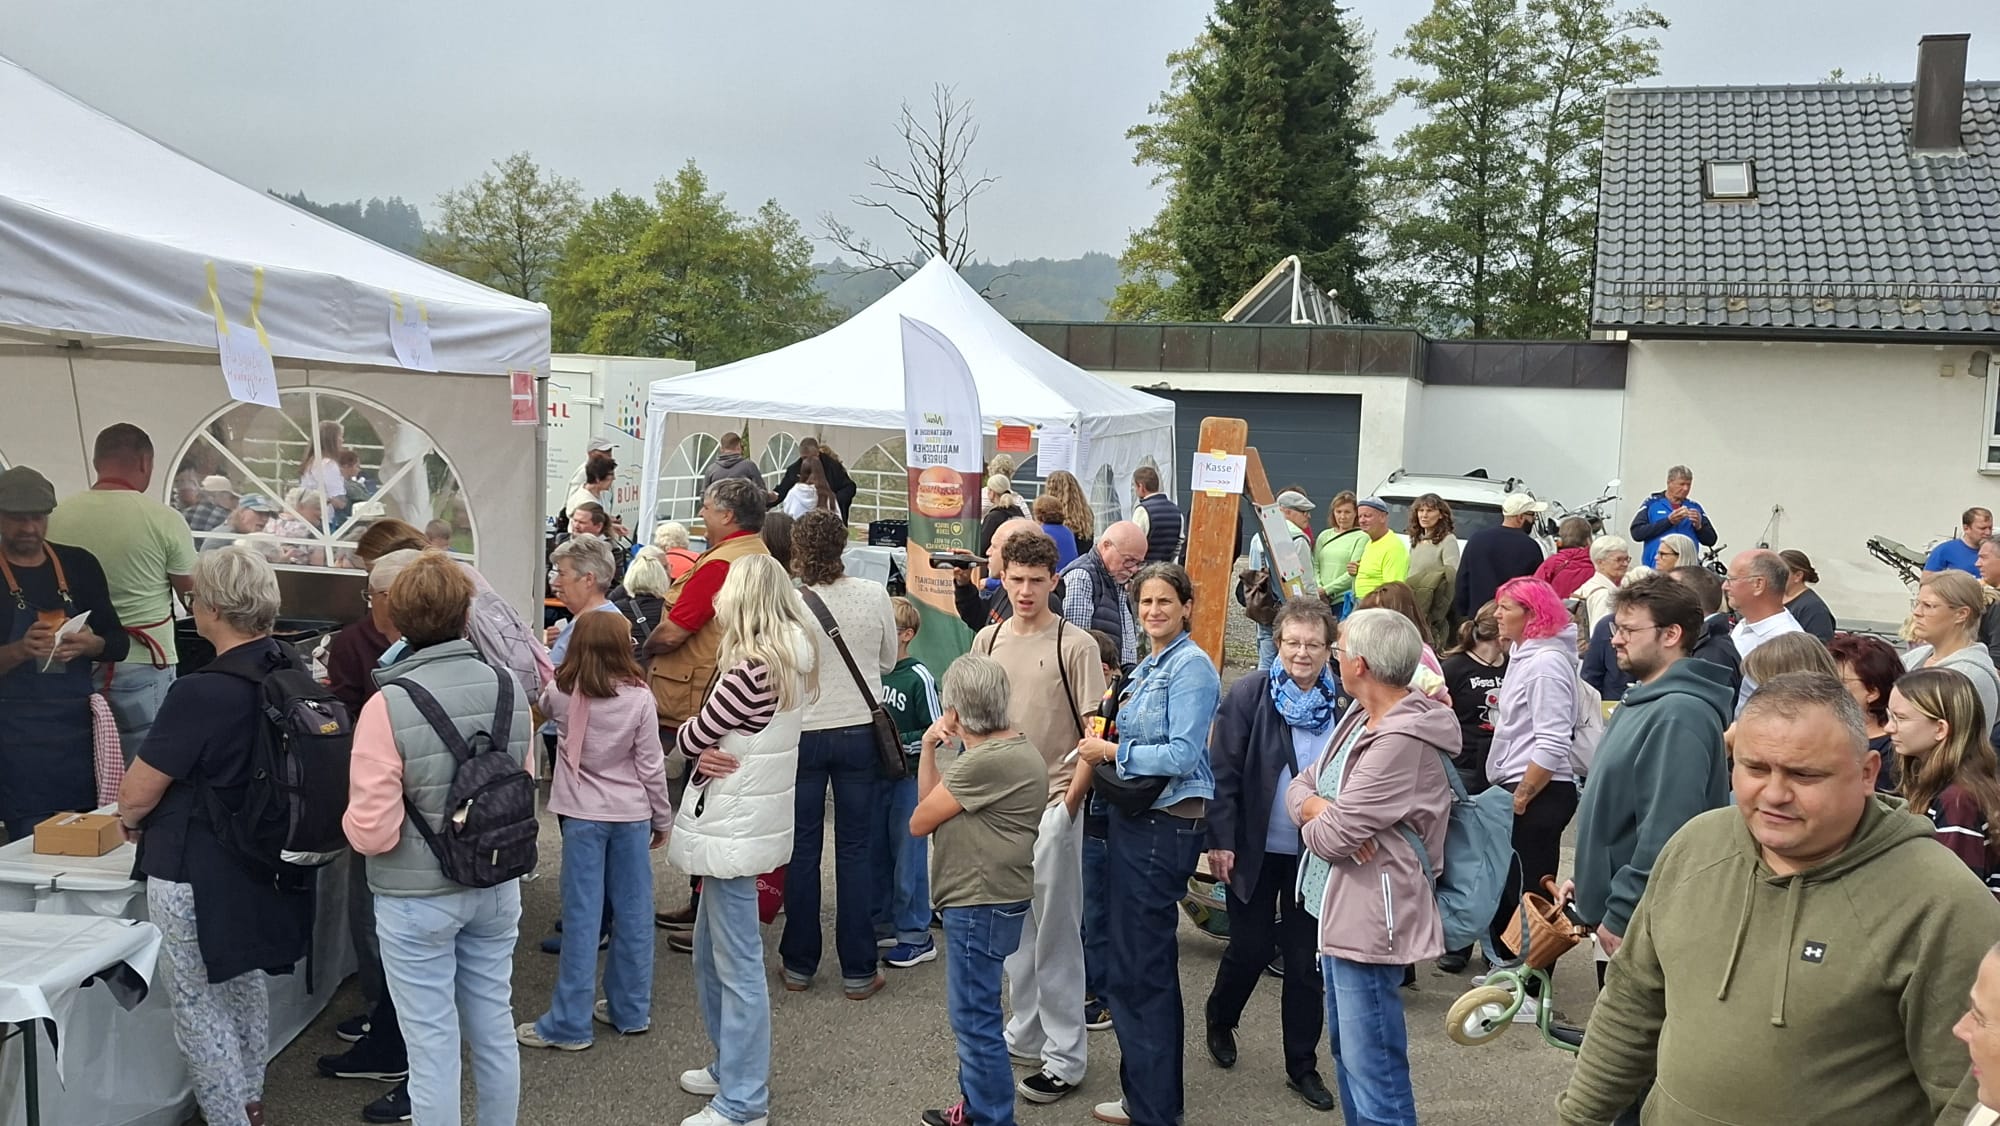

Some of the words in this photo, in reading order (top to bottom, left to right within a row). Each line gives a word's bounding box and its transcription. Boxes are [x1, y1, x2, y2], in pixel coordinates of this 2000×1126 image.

[547, 403, 570, 418] HL
[1205, 462, 1232, 473] Kasse
[617, 482, 639, 504] BÜH
[882, 685, 907, 711] DAS
